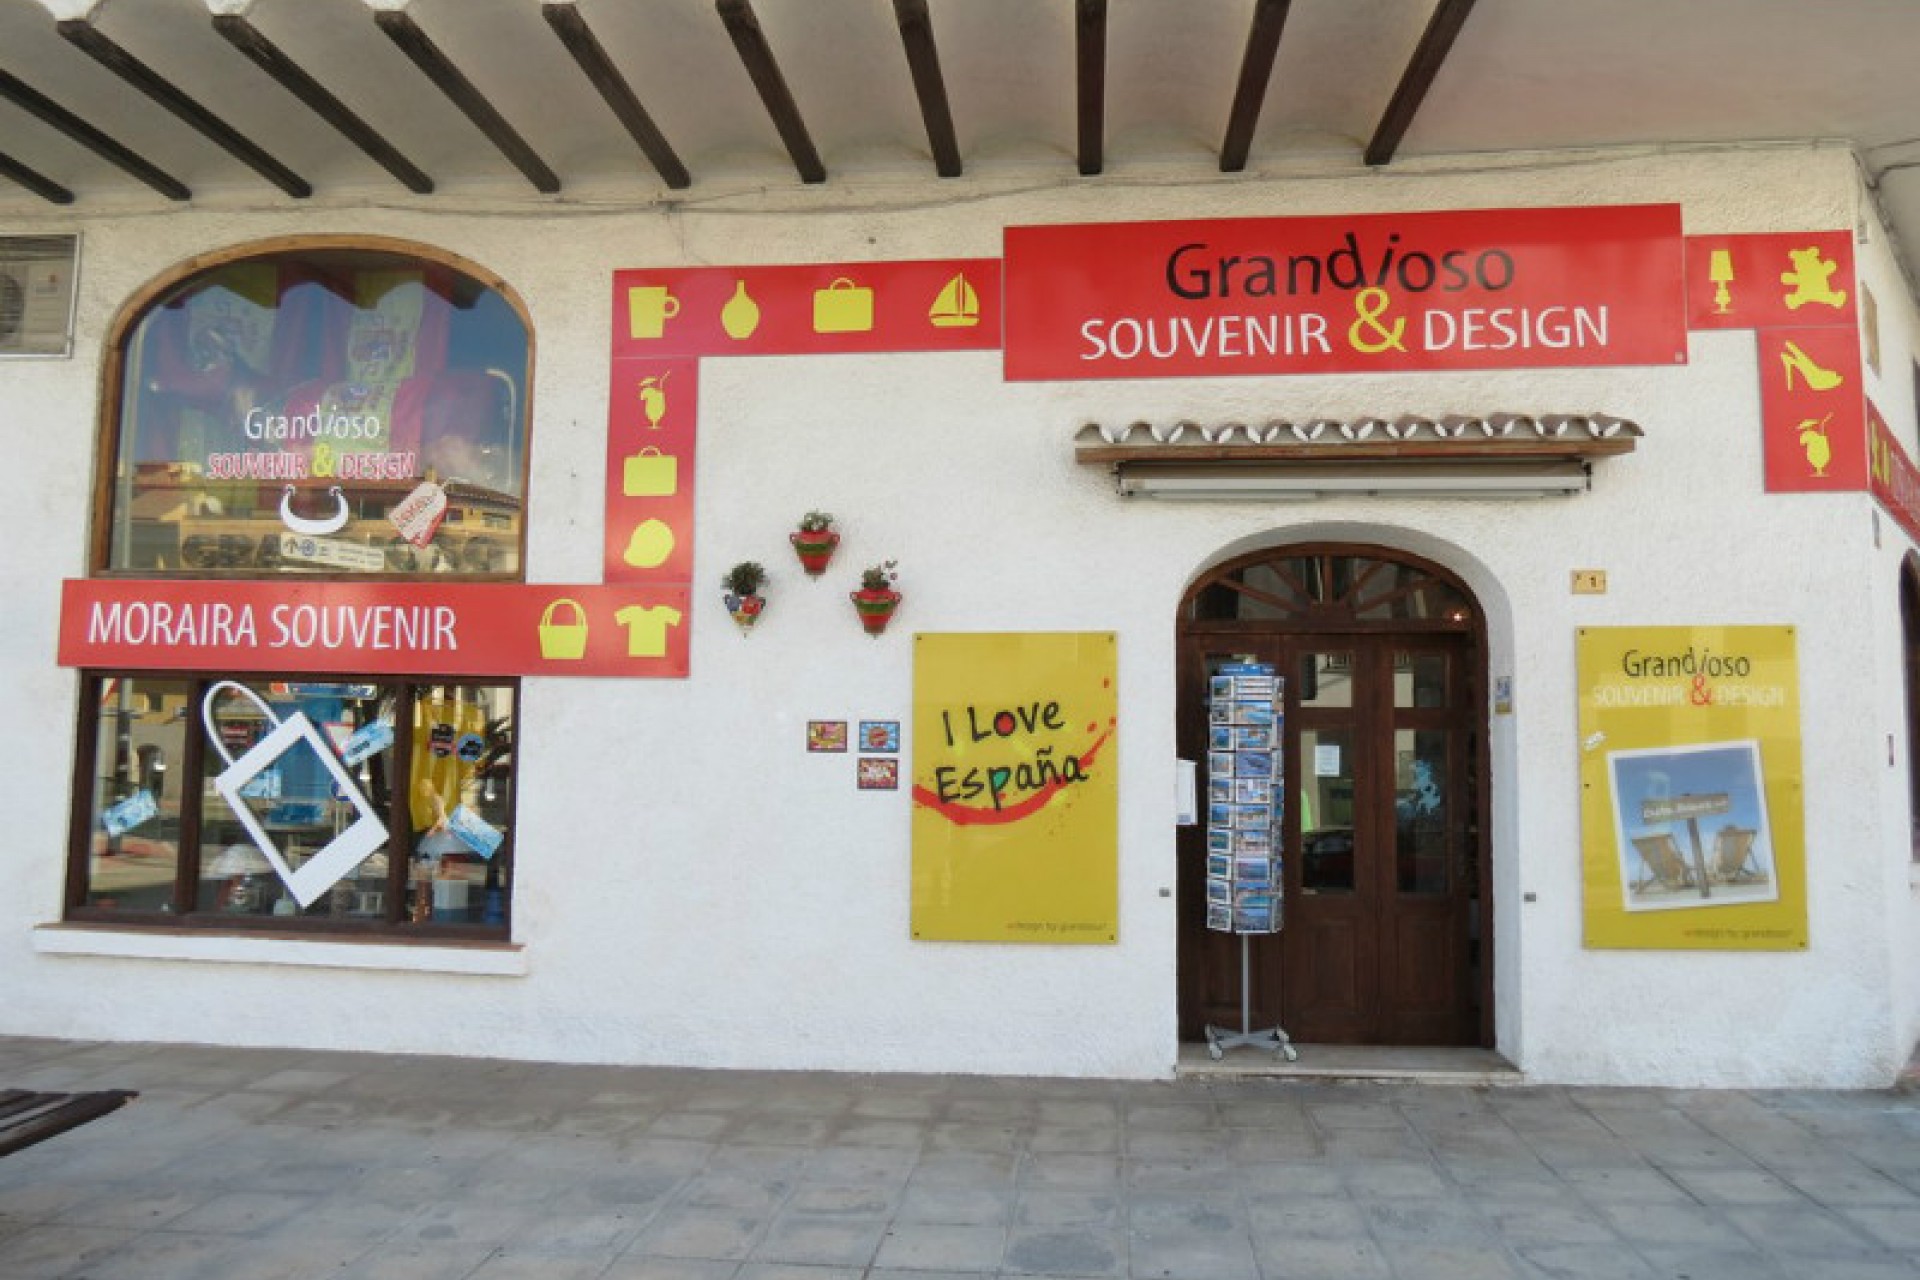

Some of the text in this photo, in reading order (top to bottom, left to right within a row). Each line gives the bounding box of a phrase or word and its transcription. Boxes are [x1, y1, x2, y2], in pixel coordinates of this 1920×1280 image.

[1165, 231, 1515, 300] Grandioso
[1080, 286, 1609, 362] SOUVENIR & DESIGN
[245, 404, 380, 440] Grandioso
[206, 442, 416, 481] SOUVENIR & DESIGN
[88, 601, 459, 652] MORAIRA SOUVENIR
[1622, 647, 1751, 678] Grandioso
[1593, 672, 1784, 708] SOUVENIR & DESIGN
[942, 708, 954, 746] I
[935, 745, 1090, 812] España
